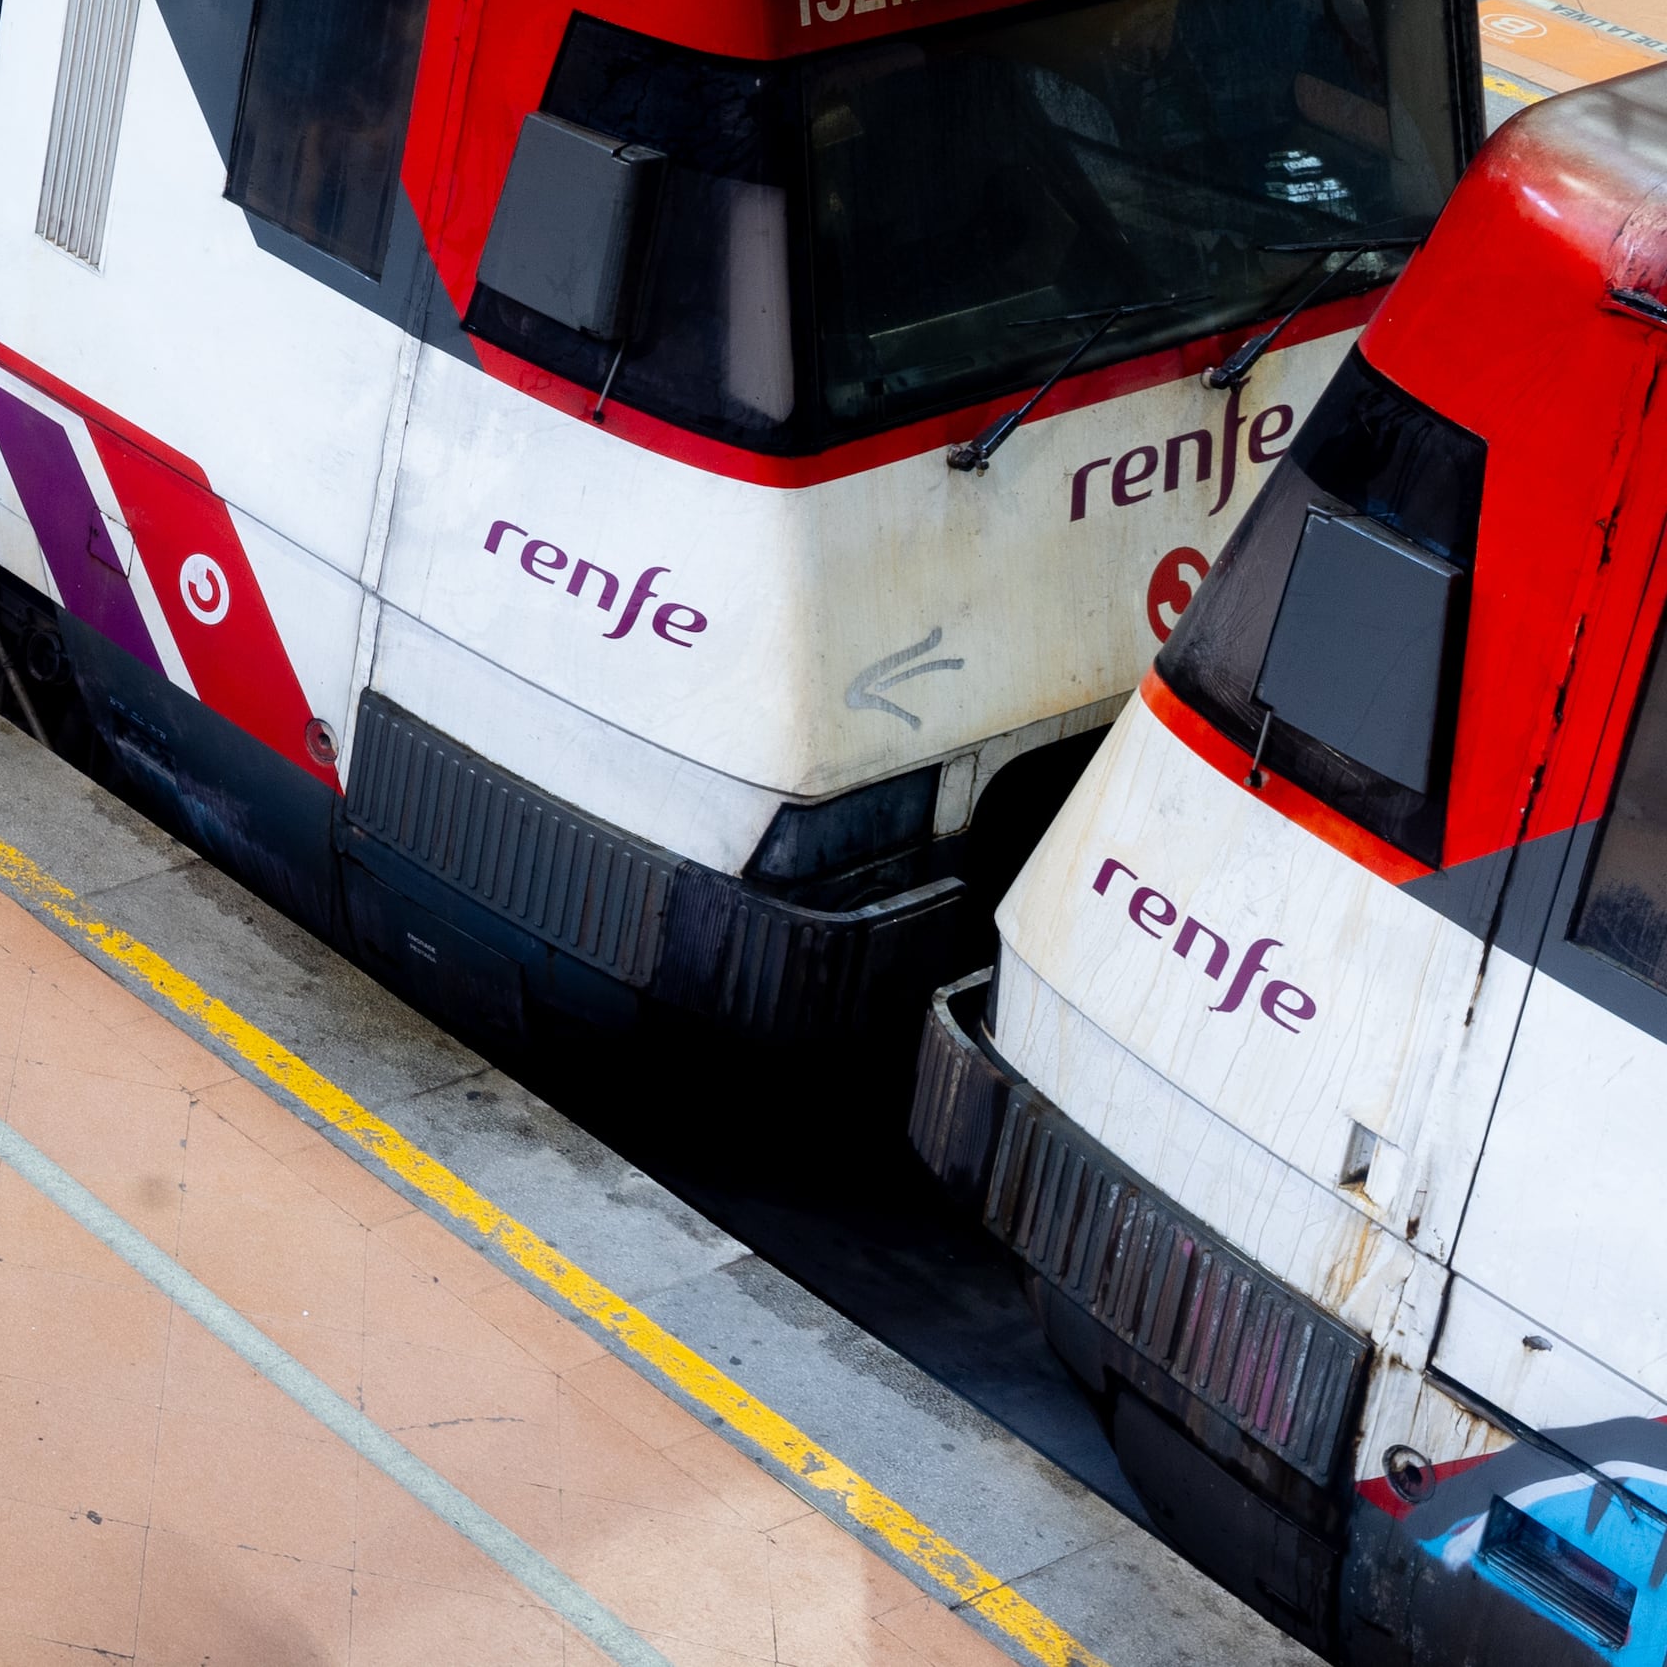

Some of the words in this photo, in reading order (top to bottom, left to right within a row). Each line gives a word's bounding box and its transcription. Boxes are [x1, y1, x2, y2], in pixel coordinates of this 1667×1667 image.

[1069, 376, 1294, 522] renfe
[483, 520, 708, 648] renfe
[1092, 858, 1317, 1035] renfe
